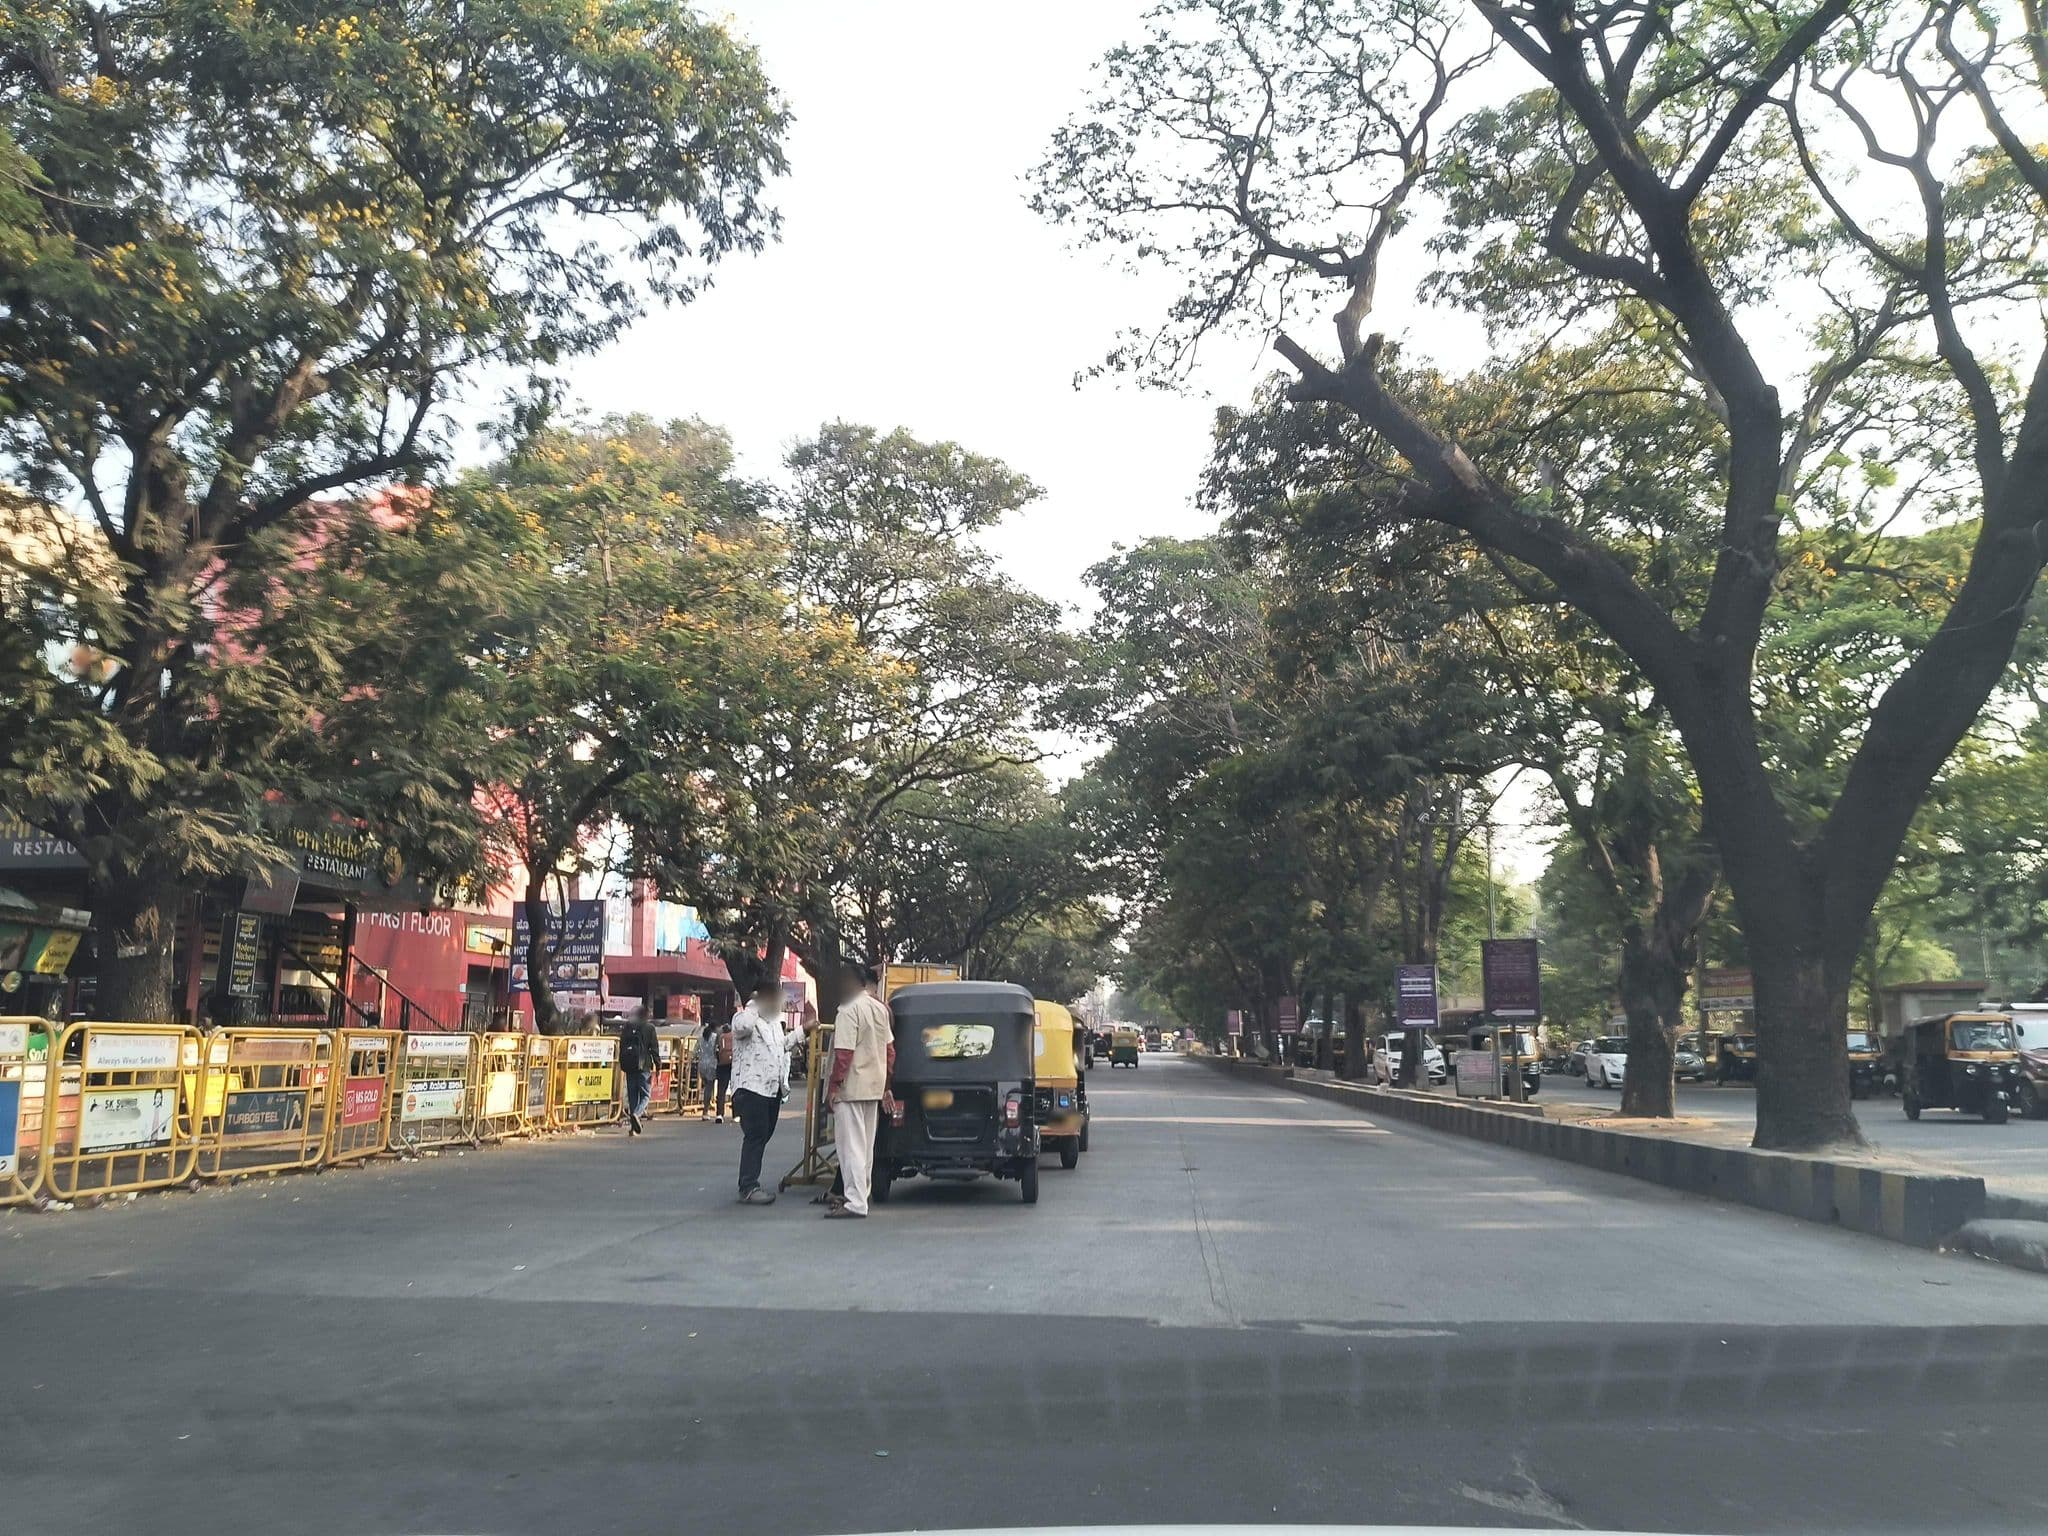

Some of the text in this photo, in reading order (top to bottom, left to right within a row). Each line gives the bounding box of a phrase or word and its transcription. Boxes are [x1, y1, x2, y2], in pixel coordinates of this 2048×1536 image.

[410, 911, 452, 937] FLOOR
[572, 944, 600, 955] BHAVAN
[97, 1057, 120, 1067] Always
[122, 1057, 138, 1065] Wear
[227, 1111, 280, 1125] TURBOSTEEL
